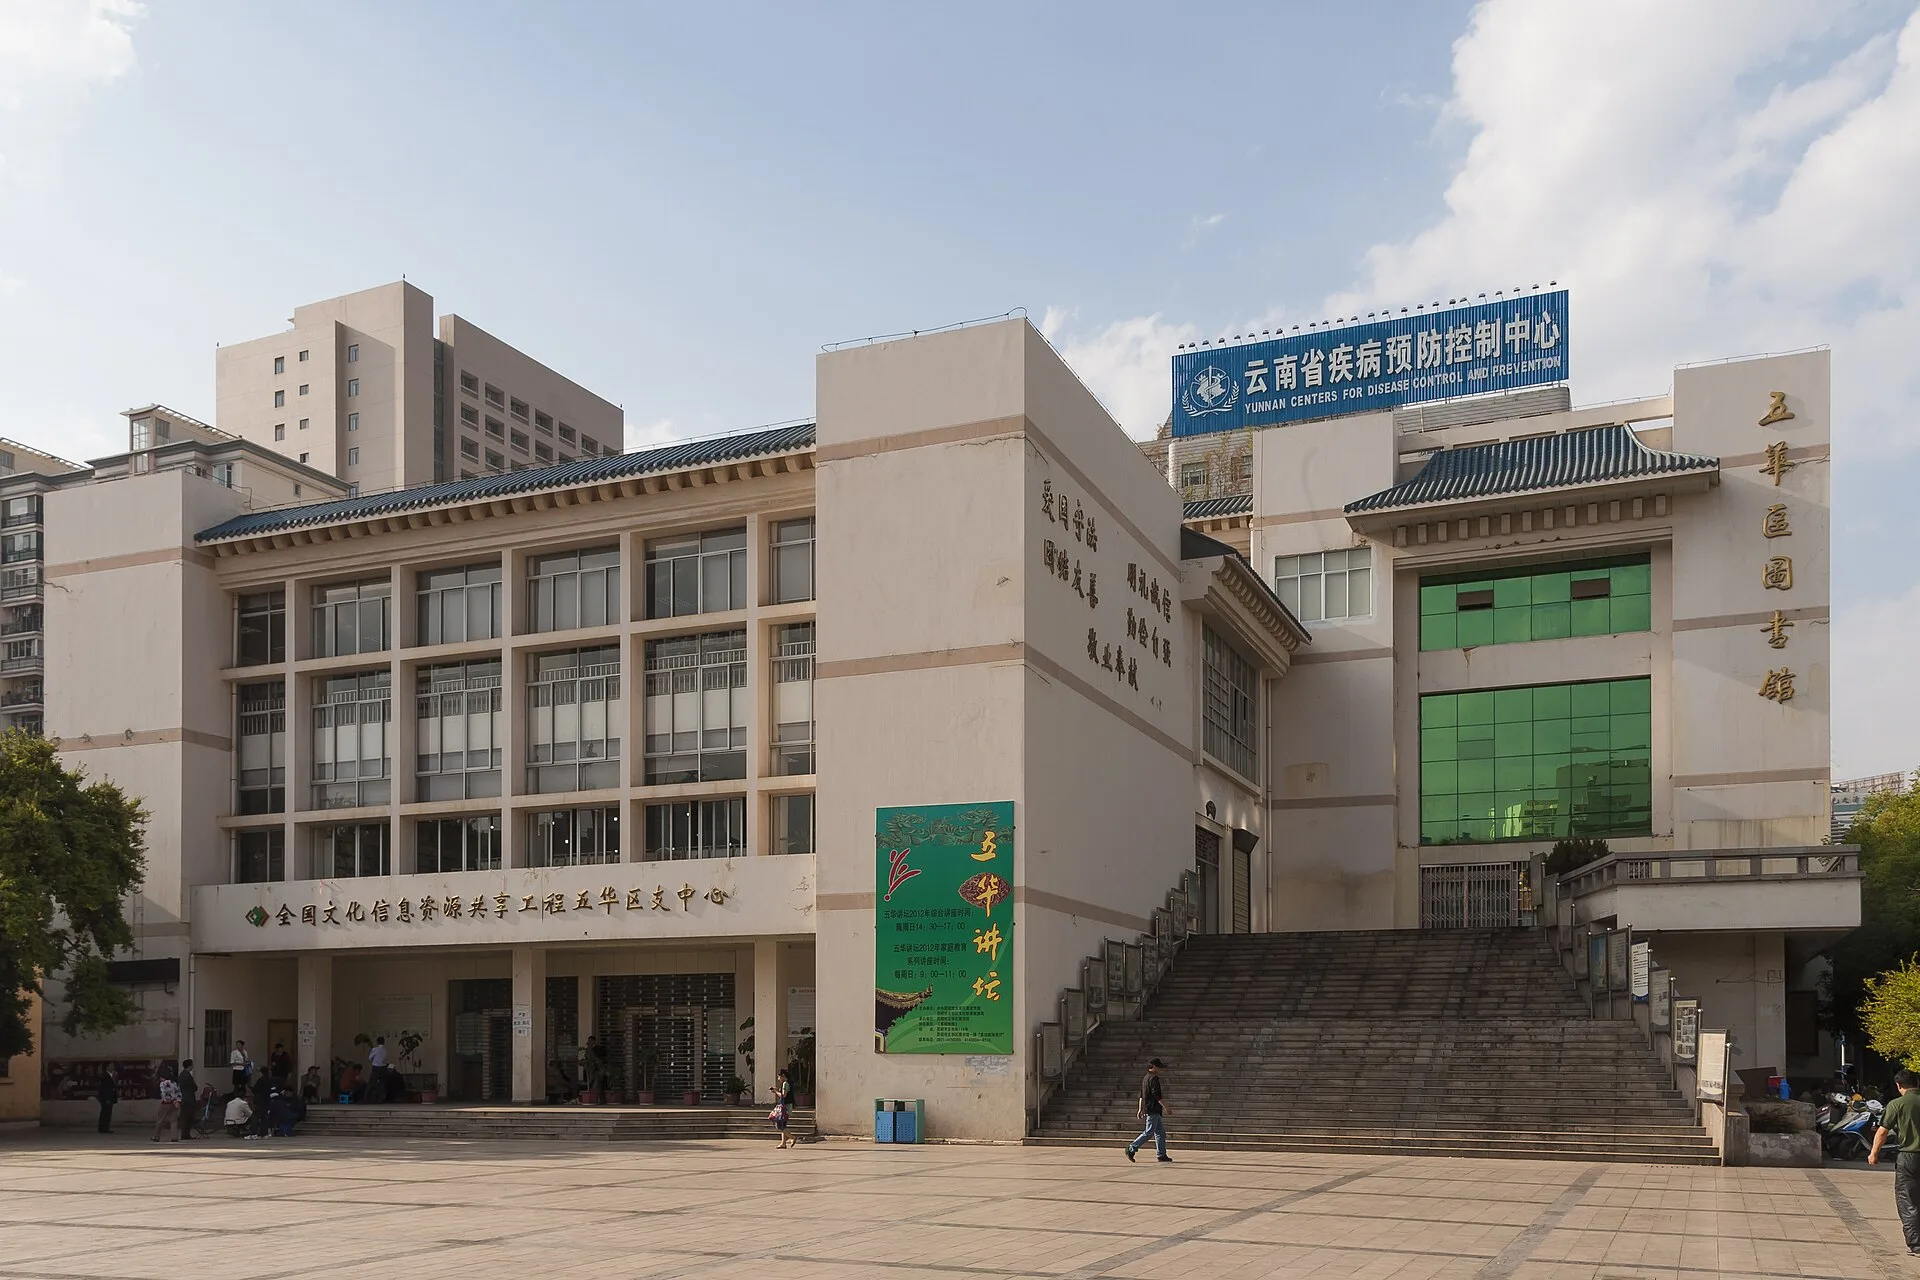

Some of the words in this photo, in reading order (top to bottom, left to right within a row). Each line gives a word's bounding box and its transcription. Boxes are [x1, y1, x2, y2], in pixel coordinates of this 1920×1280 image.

[1244, 310, 1560, 394] 云南省疾病预防控制中心
[1244, 398, 1287, 414] YUNNAN
[1291, 389, 1338, 407] CENTERS
[1342, 386, 1364, 400] FOR
[1367, 378, 1410, 396] DISEASE
[1412, 370, 1463, 389] CONTROL
[1467, 366, 1489, 381] AND
[1492, 355, 1561, 379] PREVENTION
[275, 881, 730, 927] 全国文化信息资源共享工程五华区支中心
[970, 831, 1003, 1001] 五华讲坛
